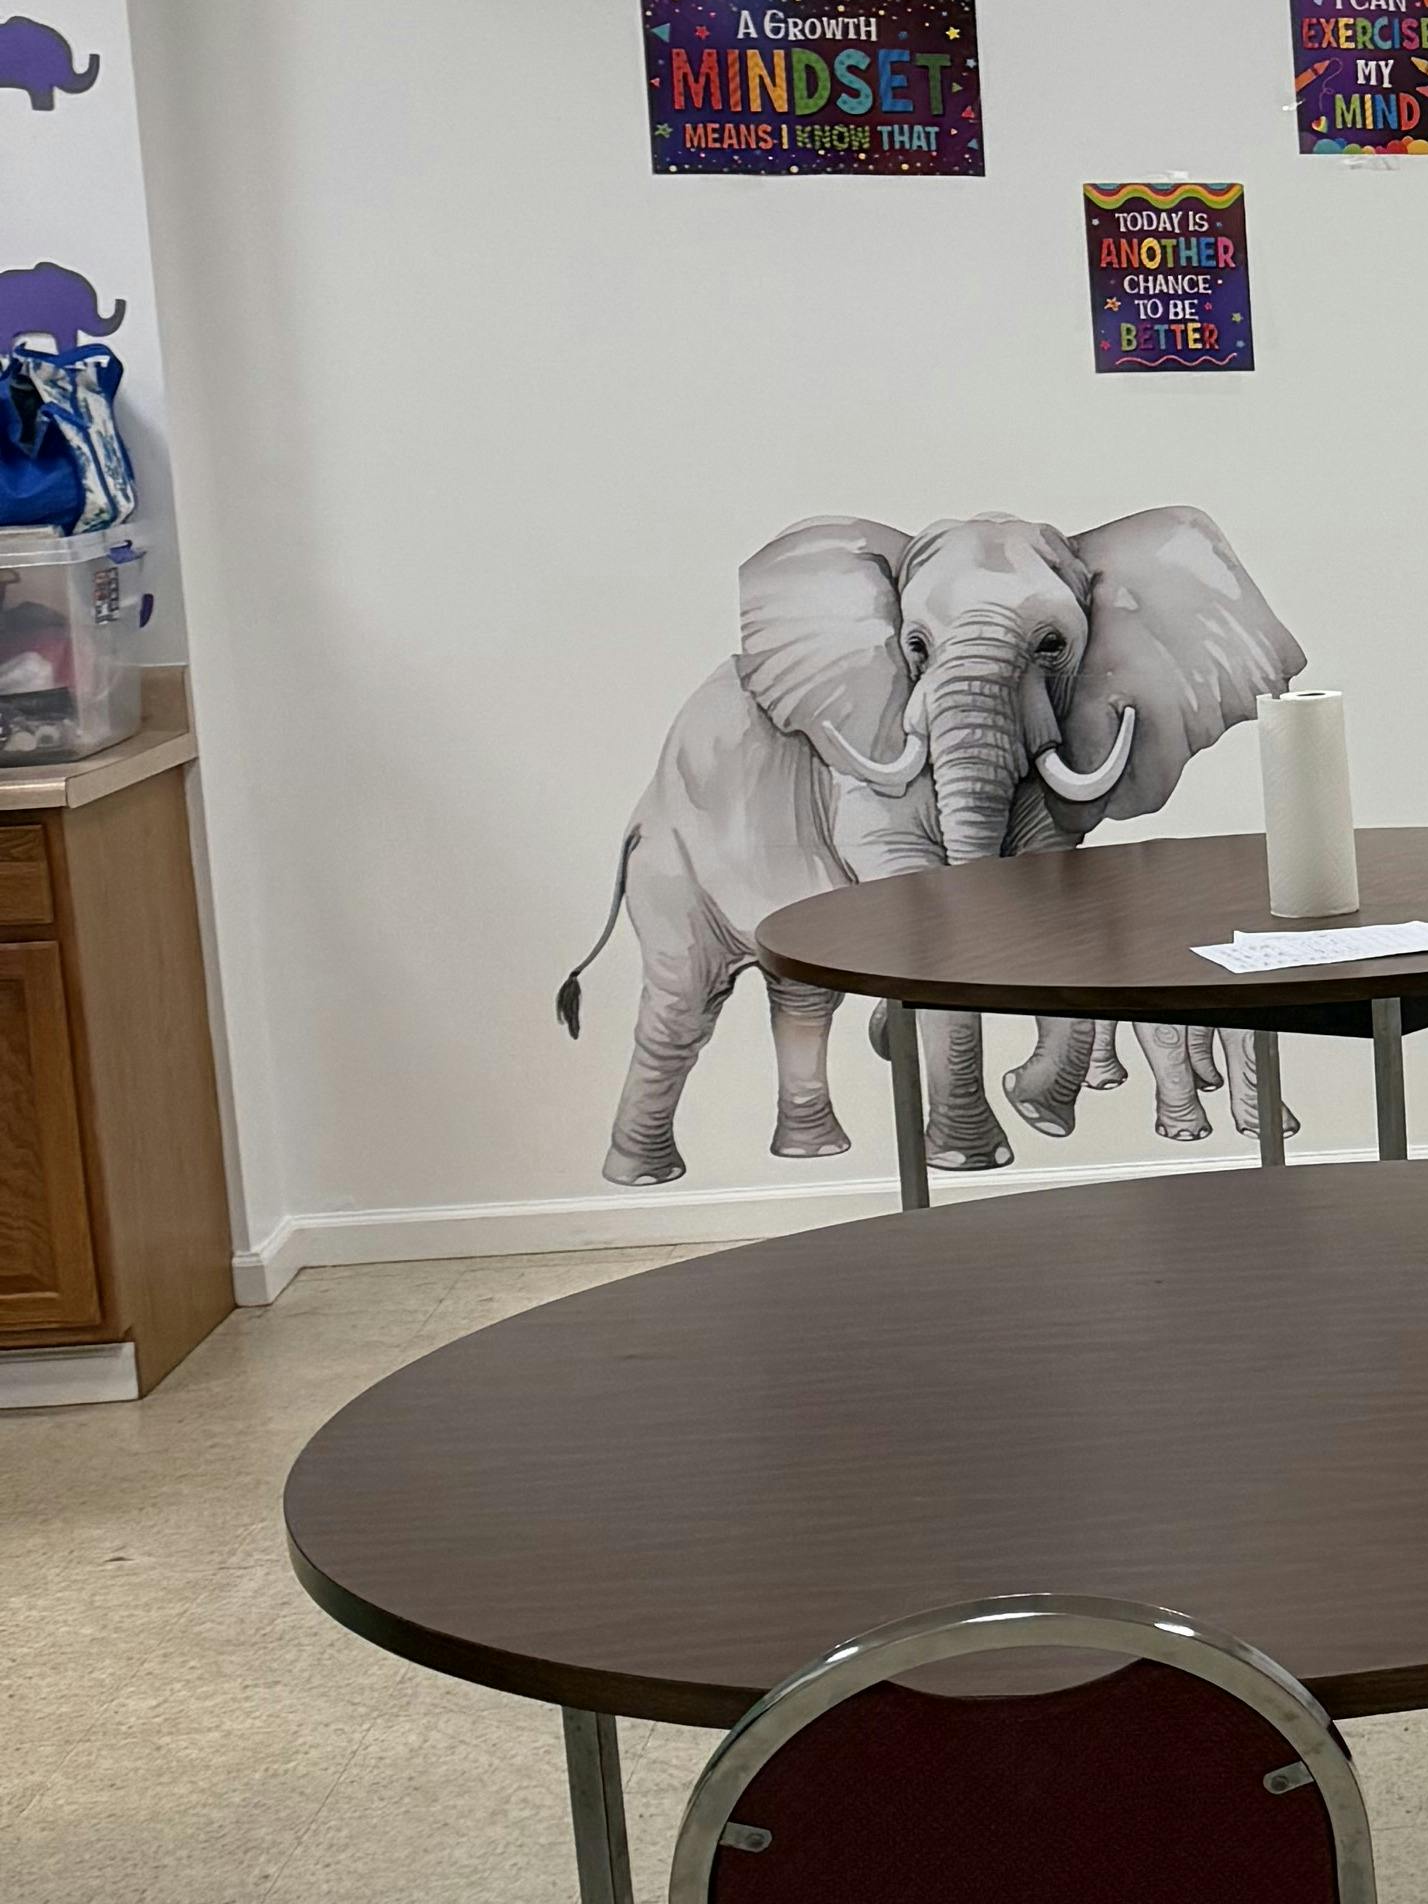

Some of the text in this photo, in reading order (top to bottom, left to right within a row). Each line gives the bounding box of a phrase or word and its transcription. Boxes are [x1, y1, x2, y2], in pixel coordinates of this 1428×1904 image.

[737, 9, 878, 41] A GROWTH
[671, 48, 951, 116] MINDSET
[1356, 59, 1394, 88] MY
[1335, 93, 1421, 131] MIND
[684, 123, 939, 151] MEANS I KNOW THAT
[1115, 211, 1209, 233] TODAY IS
[1101, 237, 1236, 269] ANOTHER
[1124, 275, 1212, 295] CHANCE
[1134, 299, 1199, 320] TO BE
[1121, 322, 1219, 352] BETTER
